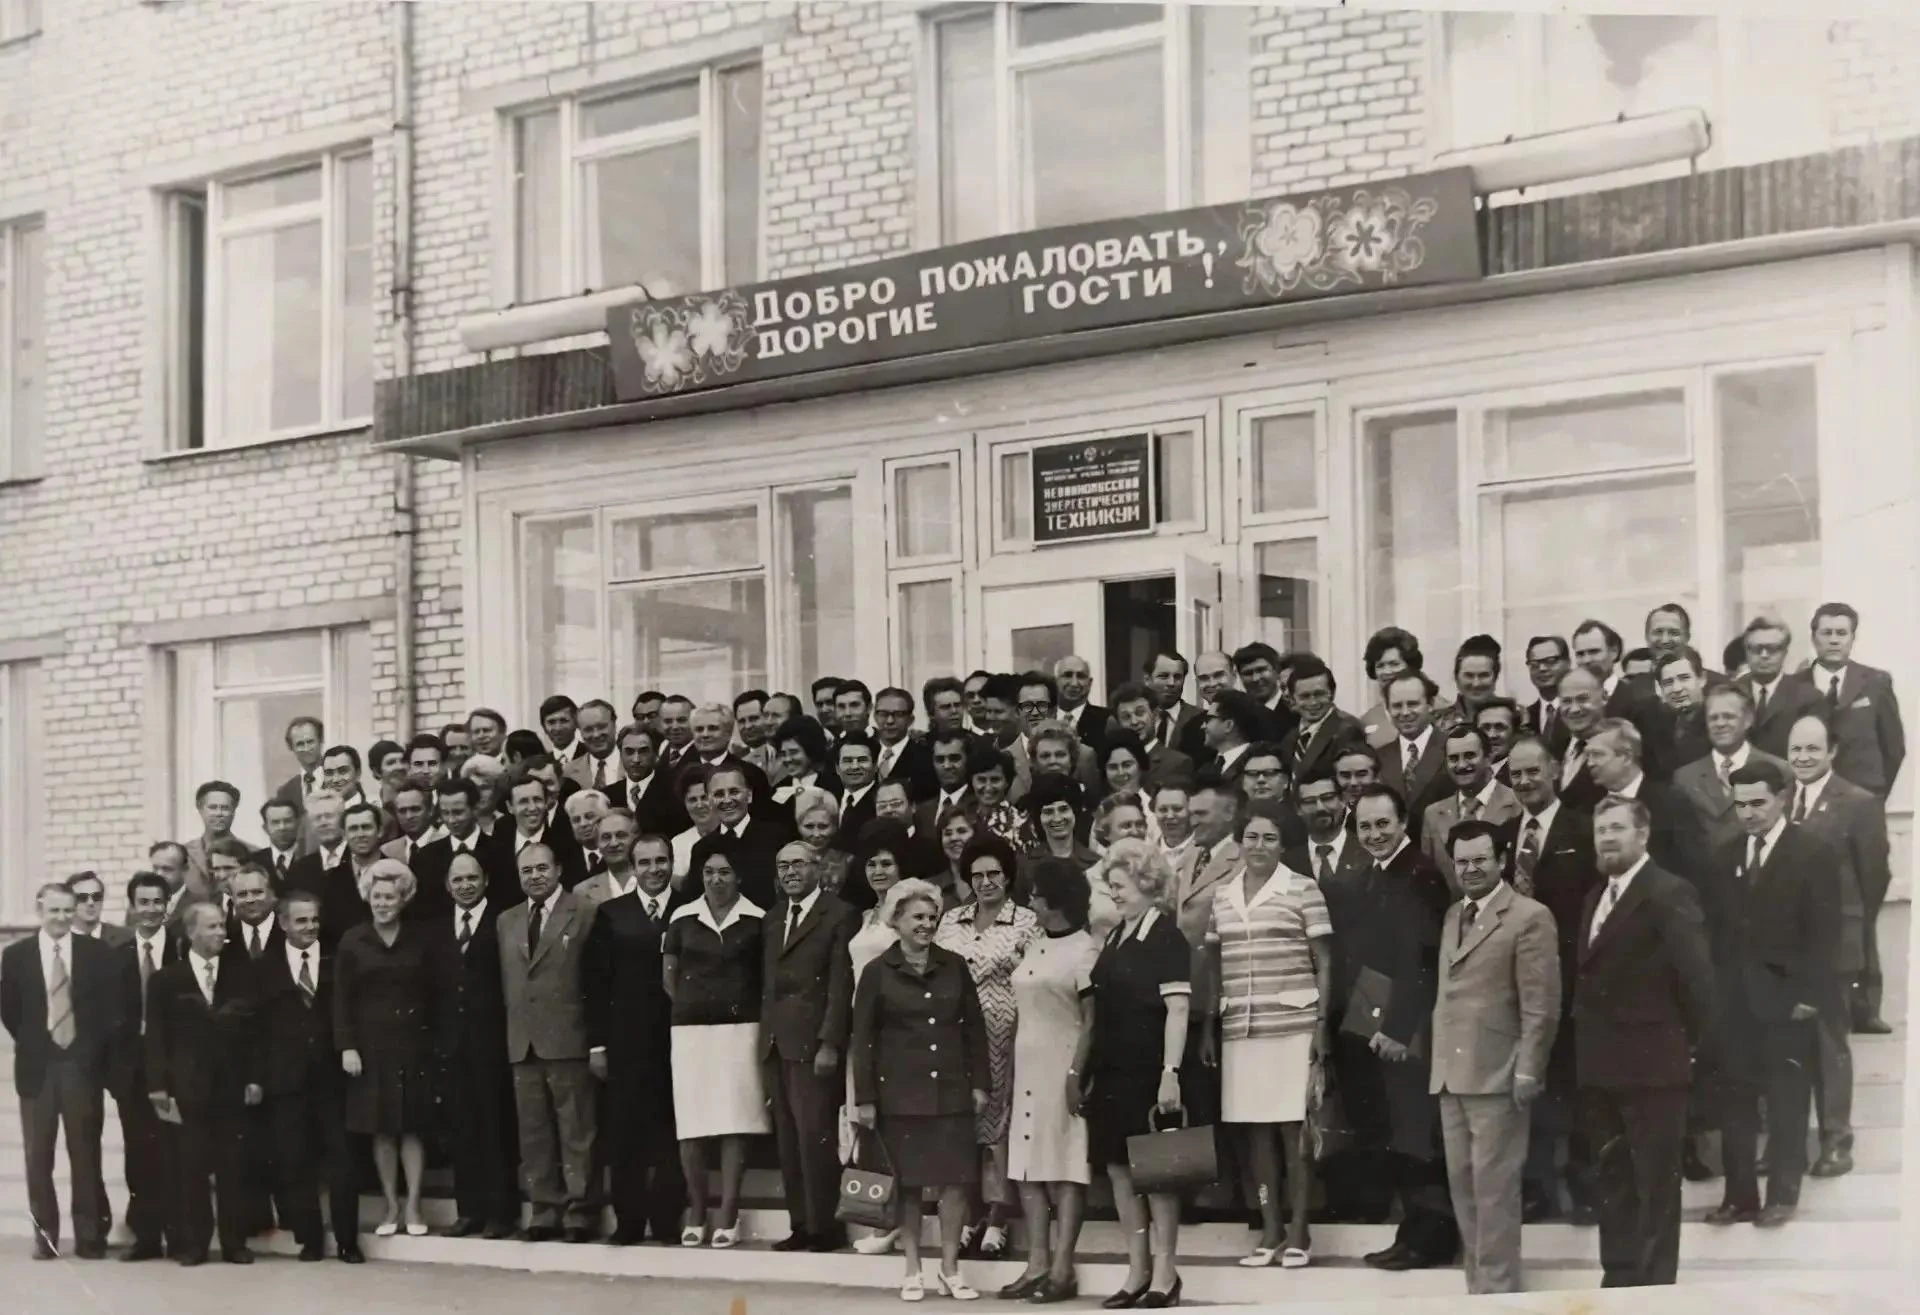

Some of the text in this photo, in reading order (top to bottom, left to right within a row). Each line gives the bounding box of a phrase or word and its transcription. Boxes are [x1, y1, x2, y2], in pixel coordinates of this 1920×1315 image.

[753, 228, 1227, 327] ДОБРО ПОЖАЛОВАТЬ,
[757, 302, 938, 359] ДОРОГИЕ
[1023, 266, 1172, 314] ГОСТИ
[1047, 505, 1140, 531] ТЕХНИКУМ
